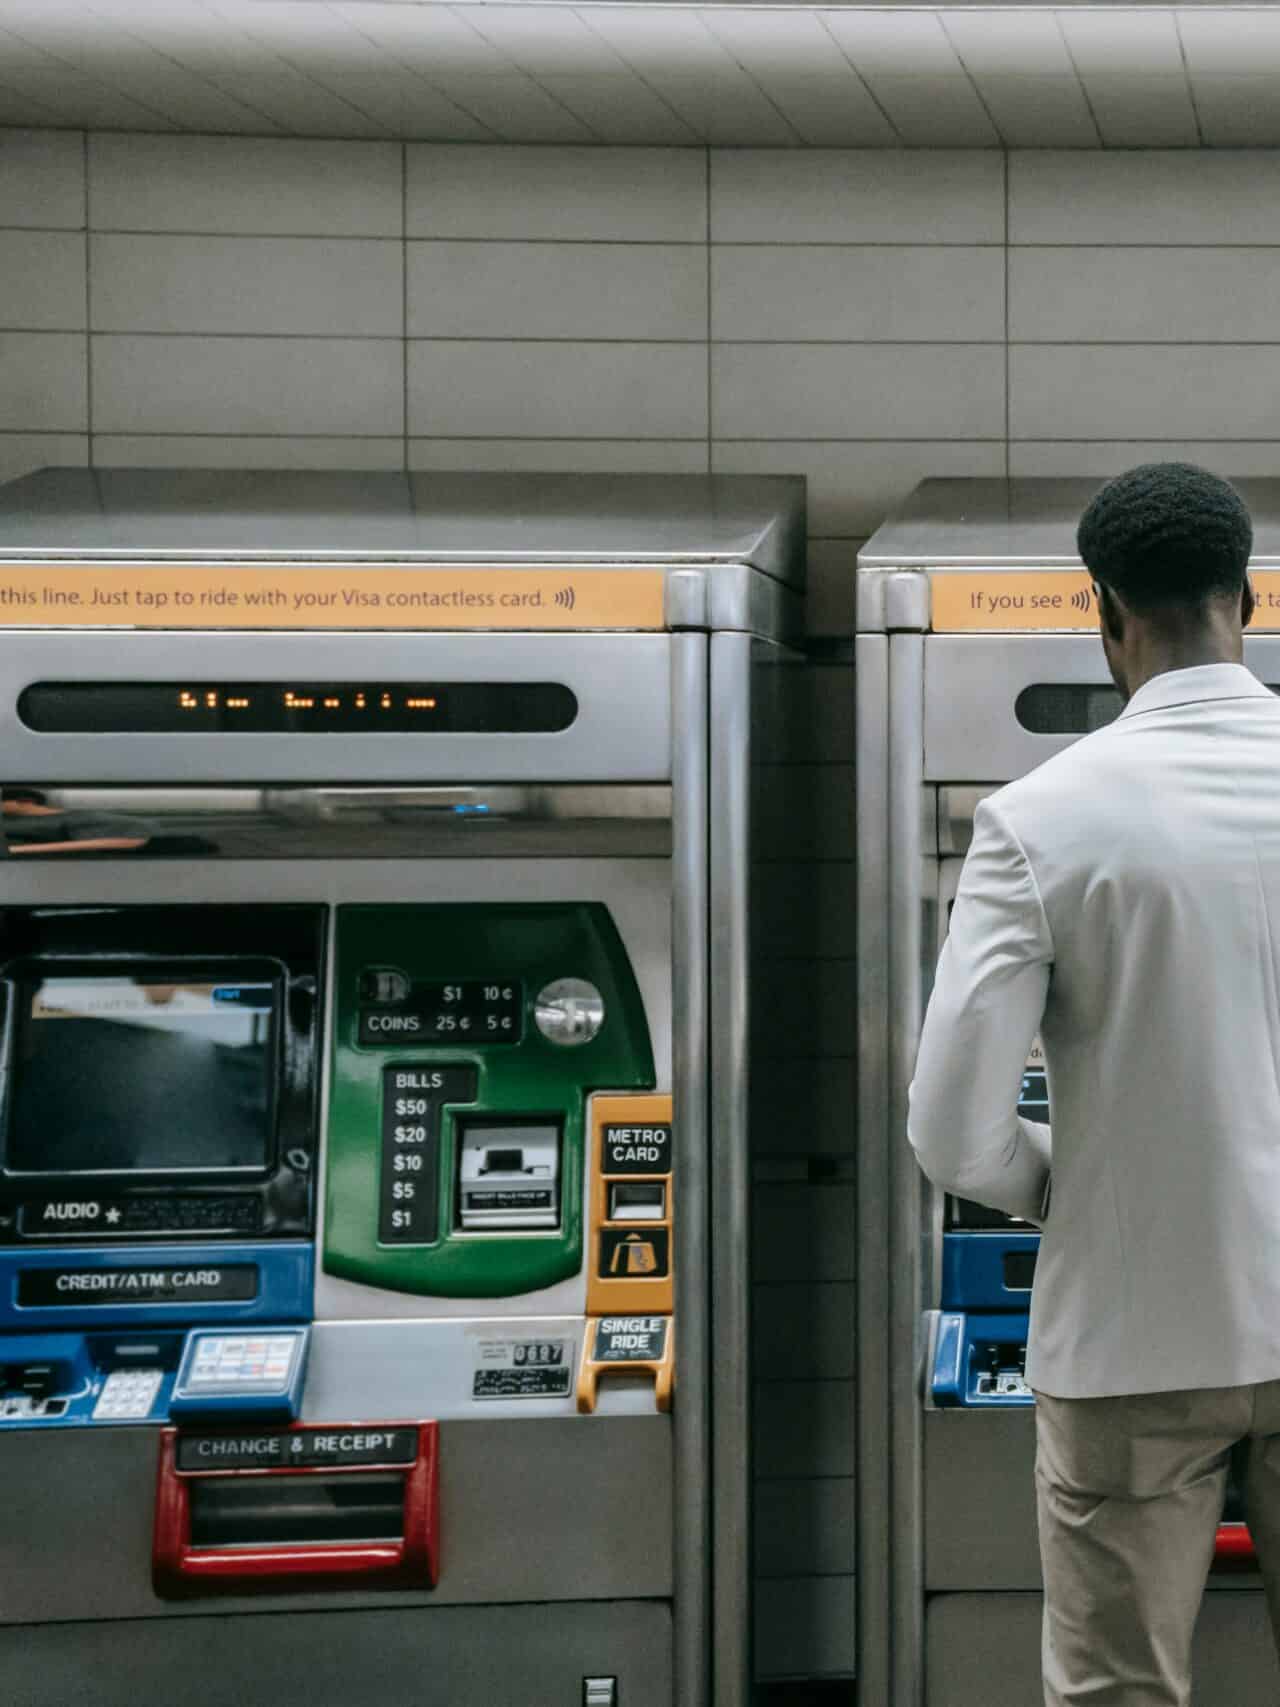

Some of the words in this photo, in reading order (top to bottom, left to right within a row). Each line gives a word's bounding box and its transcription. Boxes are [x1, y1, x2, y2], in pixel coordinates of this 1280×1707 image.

[1, 587, 38, 606] this
[43, 587, 85, 606] line.
[91, 588, 129, 607] Just
[136, 590, 169, 609] tap
[174, 589, 194, 606] to
[200, 588, 239, 606] ride
[244, 588, 287, 606] with
[293, 591, 338, 610] your
[341, 589, 381, 607] Visa
[386, 588, 495, 607] contactless
[971, 591, 985, 608] If
[988, 594, 1025, 613] you
[1031, 594, 1063, 609] see
[443, 985, 463, 1001] $1
[367, 1016, 420, 1031] COINS
[396, 1073, 443, 1088] BILLS
[395, 1098, 427, 1116] $50
[394, 1126, 426, 1144] $20
[607, 1129, 667, 1144] METRO
[612, 1147, 660, 1162] CARD
[393, 1155, 423, 1172] $10
[392, 1182, 414, 1199] $5
[43, 1203, 98, 1219] AUDIO
[391, 1210, 412, 1227] $1
[57, 1272, 164, 1290] CREDIT/ATM
[172, 1271, 221, 1286] CARD
[601, 1319, 661, 1334] SINGLE
[611, 1334, 650, 1349] RIDE
[199, 1438, 280, 1456] CHANGE
[291, 1437, 303, 1452] &
[314, 1433, 396, 1452] RECEIPT
